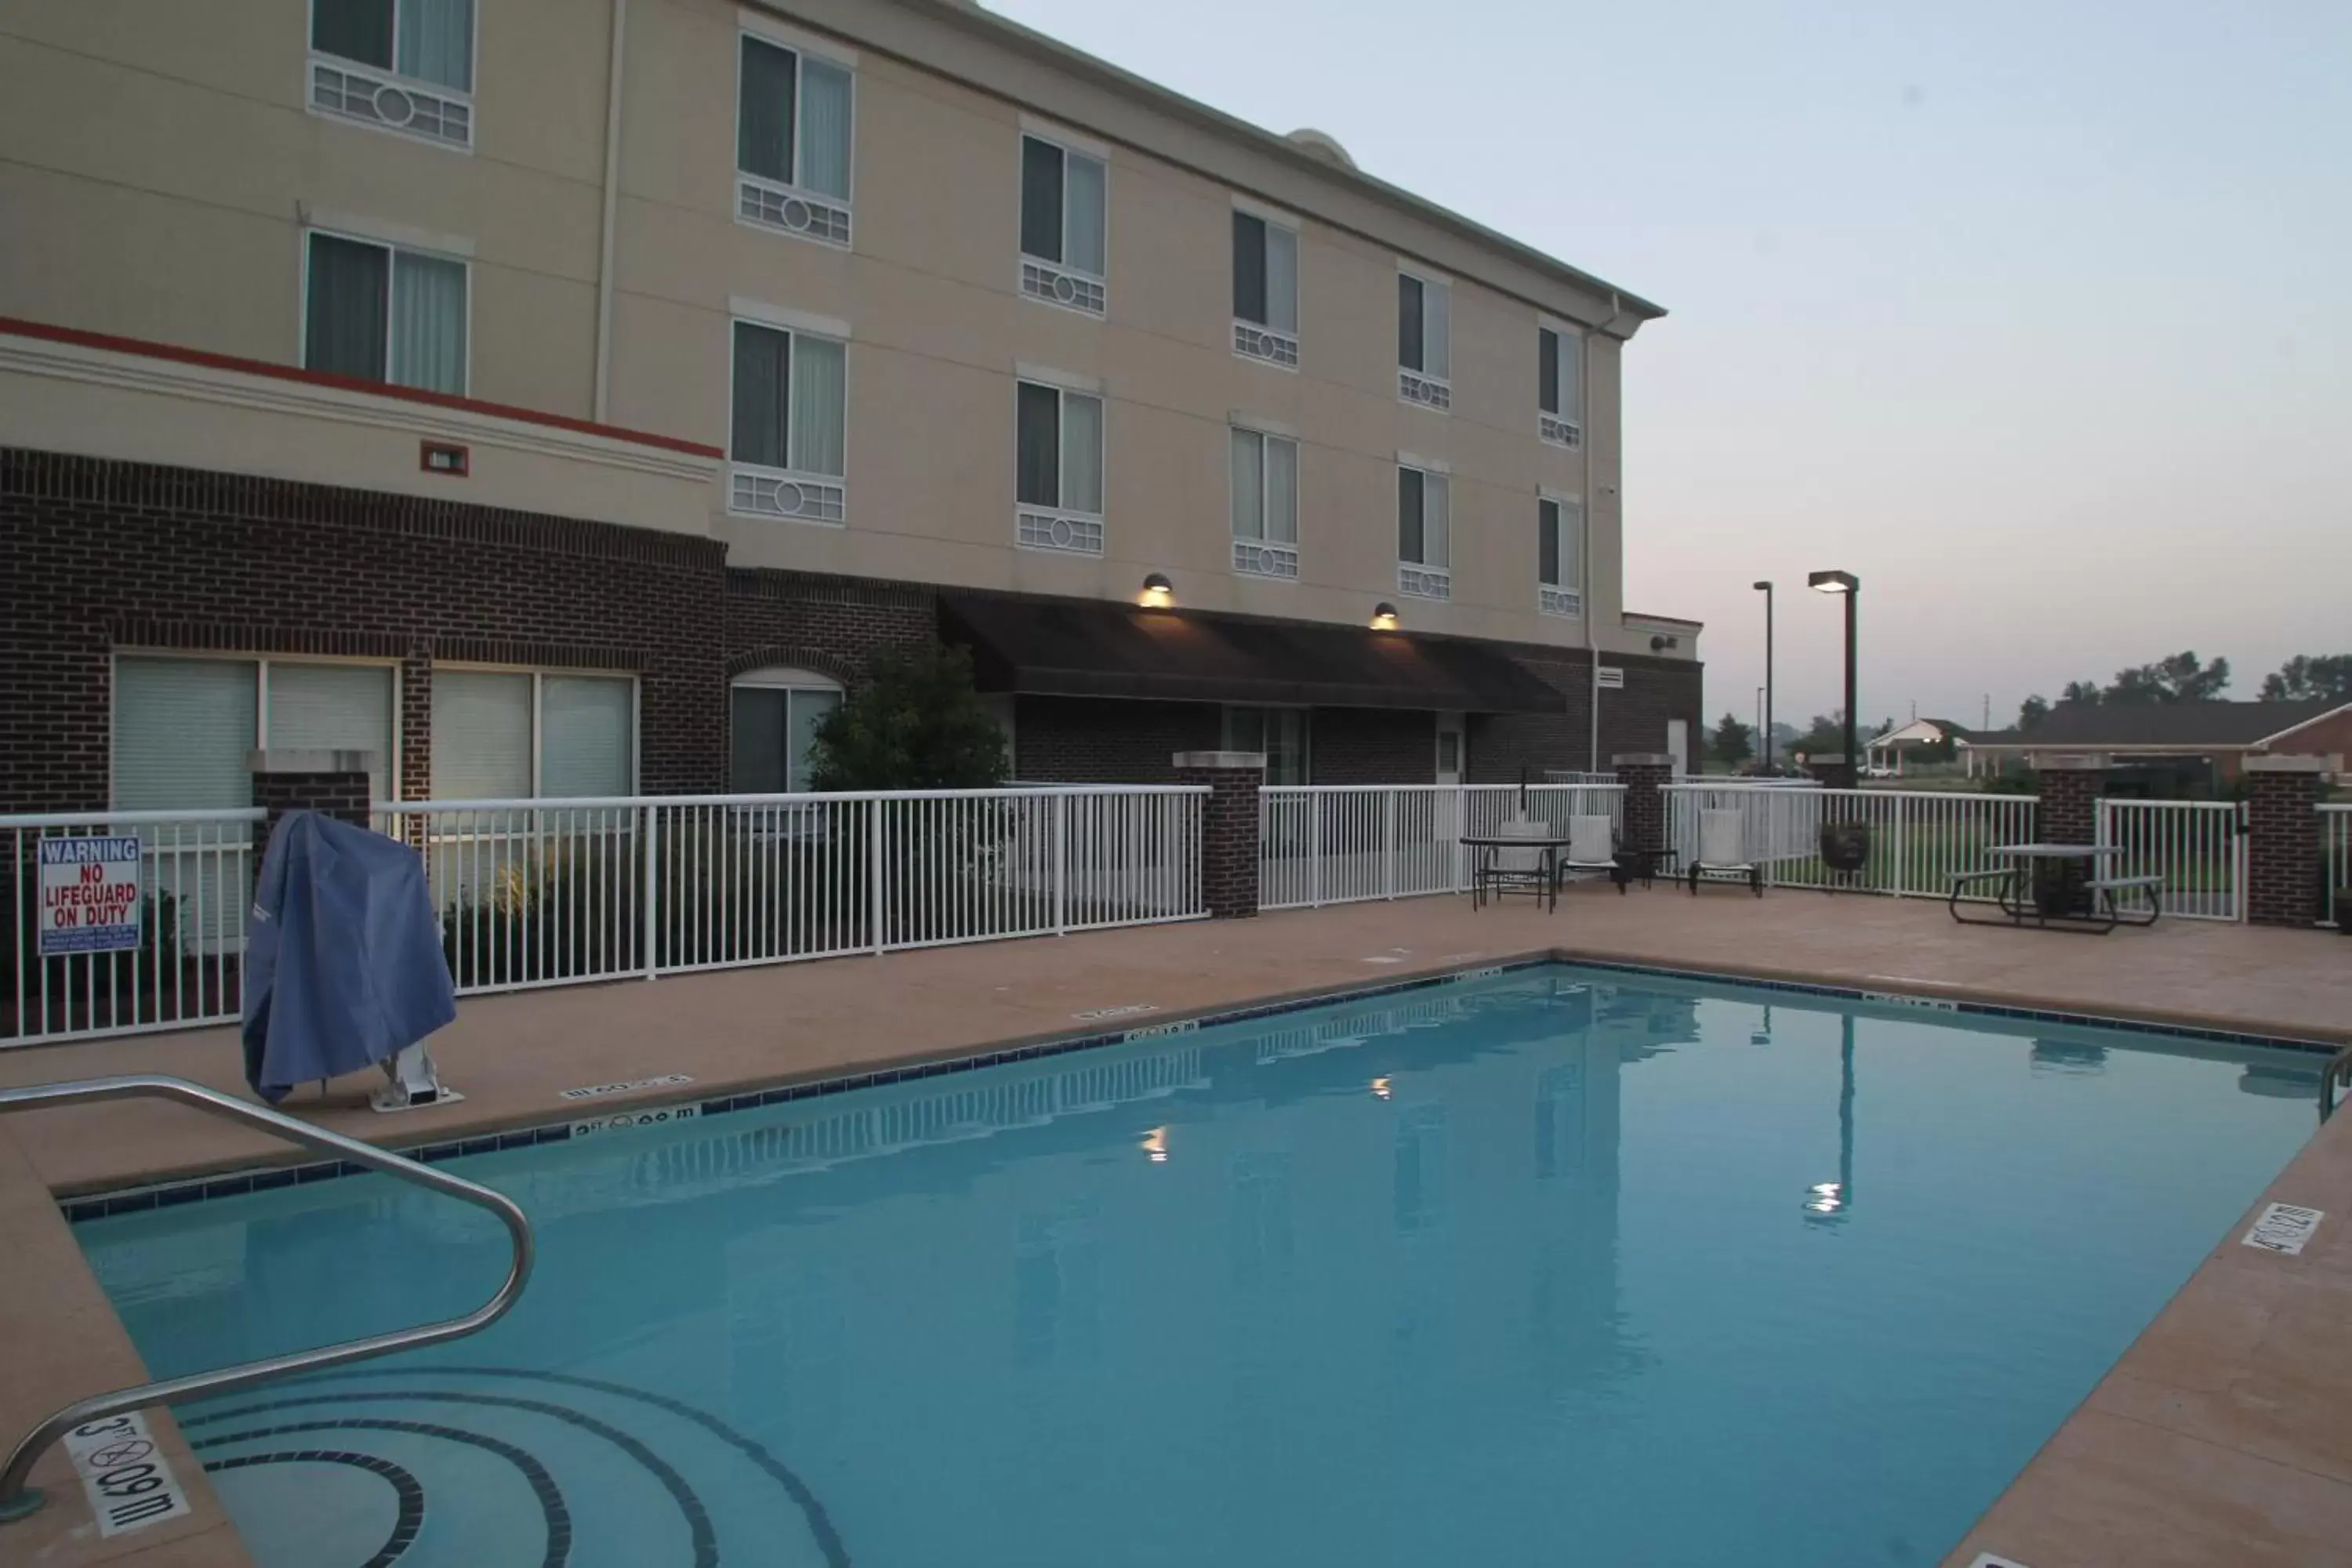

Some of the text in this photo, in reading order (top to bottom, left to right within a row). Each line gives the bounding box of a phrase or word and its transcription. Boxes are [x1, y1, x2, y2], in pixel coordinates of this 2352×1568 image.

[44, 840, 136, 863] WARNING
[80, 864, 103, 883] NO
[45, 883, 136, 907] LIFEGUARD
[54, 905, 128, 927] ON DUTY
